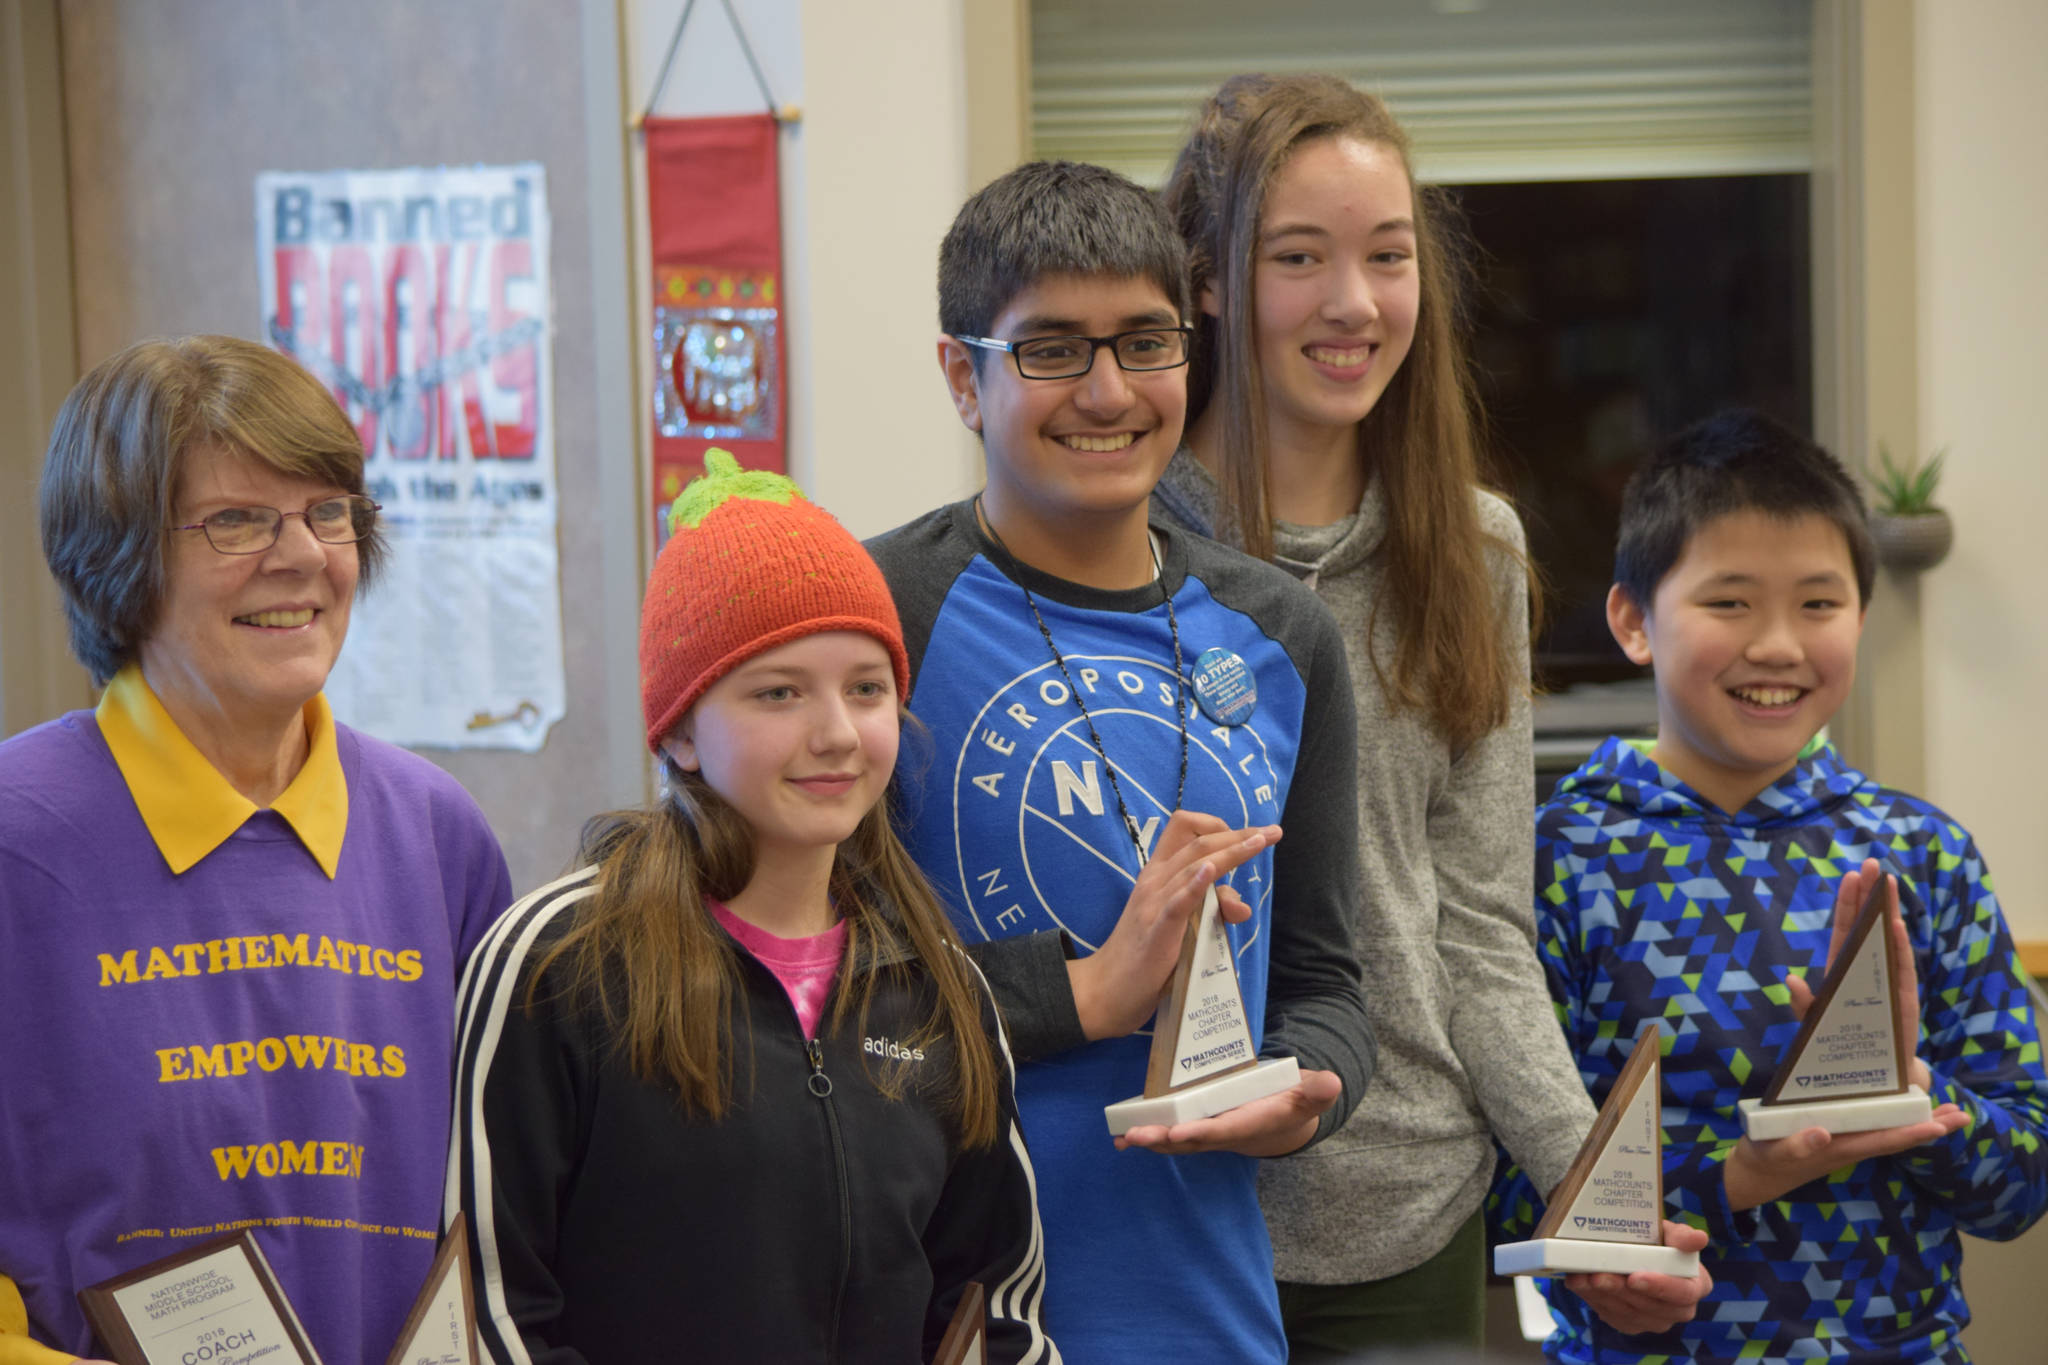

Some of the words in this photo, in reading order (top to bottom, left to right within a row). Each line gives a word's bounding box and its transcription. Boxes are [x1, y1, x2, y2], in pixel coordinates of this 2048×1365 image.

[274, 178, 532, 243] Banned
[409, 472, 457, 500] the
[1208, 656, 1242, 680] TYPES
[977, 868, 1038, 935] NE
[97, 933, 423, 987] MATHEMATICS
[1187, 998, 1238, 1021] MATHCOUNTS
[1202, 994, 1219, 1007] 2018
[1192, 1018, 1242, 1041] COMPETITION
[1198, 1011, 1232, 1029] CHAPTER
[155, 1035, 407, 1082] EMPOWERS
[863, 1036, 925, 1061] adidas
[1193, 1041, 1244, 1063] MATHCOUNTS
[1818, 1049, 1888, 1063] COMPETITION
[1828, 1041, 1876, 1053] CHAPTER
[1813, 1070, 1887, 1082] MATHCOUNTS
[210, 1139, 365, 1181] WOMEN
[1593, 1178, 1653, 1190] MATHCOUNTS
[1613, 1170, 1633, 1179] 2018
[1593, 1197, 1653, 1209] COMPETITION
[1602, 1188, 1643, 1199] CHAPTER
[169, 1225, 212, 1238] UNITED
[215, 1218, 263, 1232] NATIONS
[302, 1216, 342, 1228] WORLD
[1588, 1217, 1651, 1229] MATHCOUNTS
[144, 1290, 185, 1313] MIDDLE
[185, 1276, 233, 1297] SCHOOL
[150, 1269, 217, 1301] NATIONWIDE
[150, 1304, 181, 1321] MATH
[182, 1282, 236, 1309] PROGRAM
[197, 1327, 227, 1345] 2018
[447, 1302, 460, 1350] FIRST
[181, 1329, 257, 1365] COACH
[218, 1342, 282, 1365] Competition
